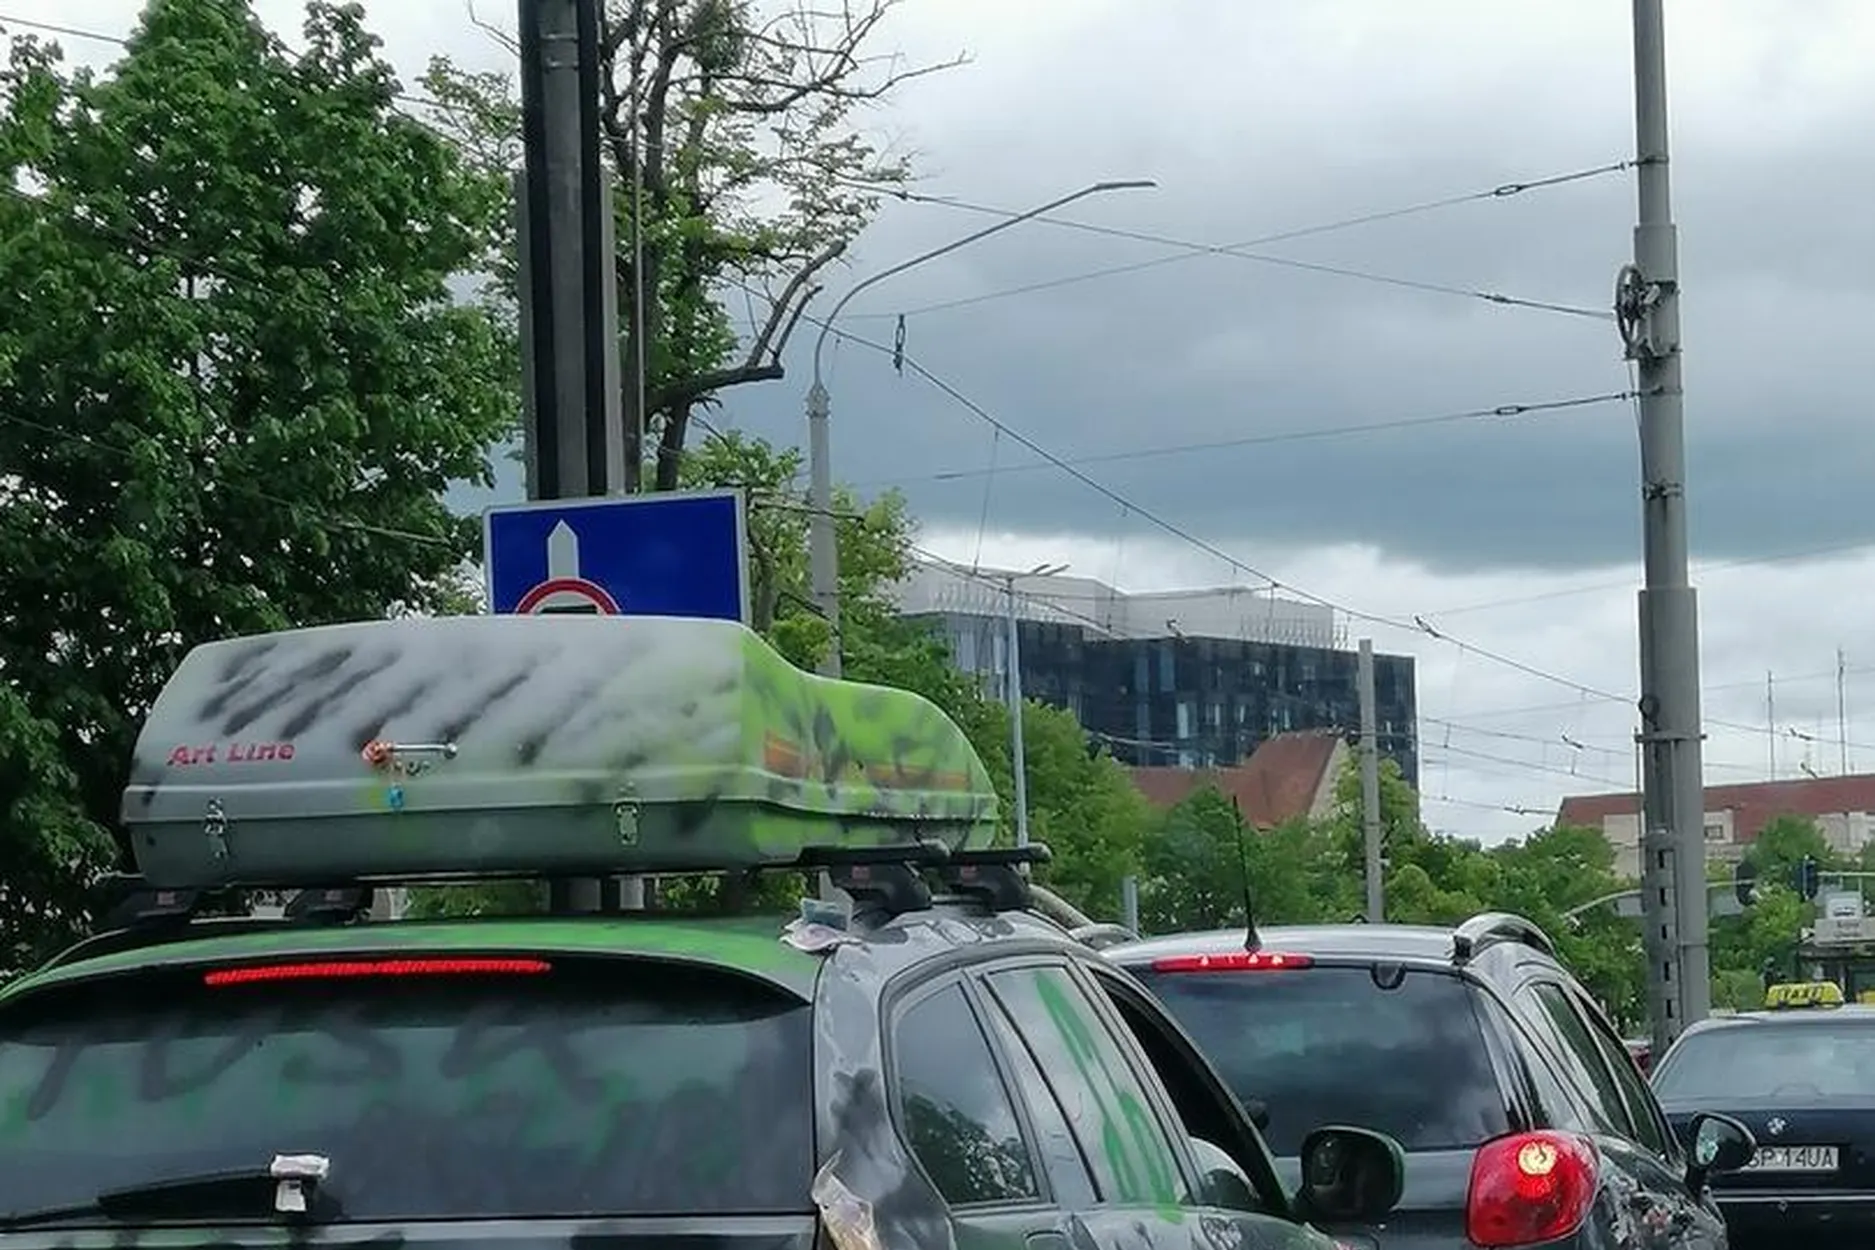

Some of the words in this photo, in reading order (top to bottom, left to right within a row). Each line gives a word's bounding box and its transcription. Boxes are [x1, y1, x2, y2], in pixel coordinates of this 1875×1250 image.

[166, 744, 217, 766] Art
[227, 742, 296, 763] Line
[1780, 986, 1822, 1001] TAXI
